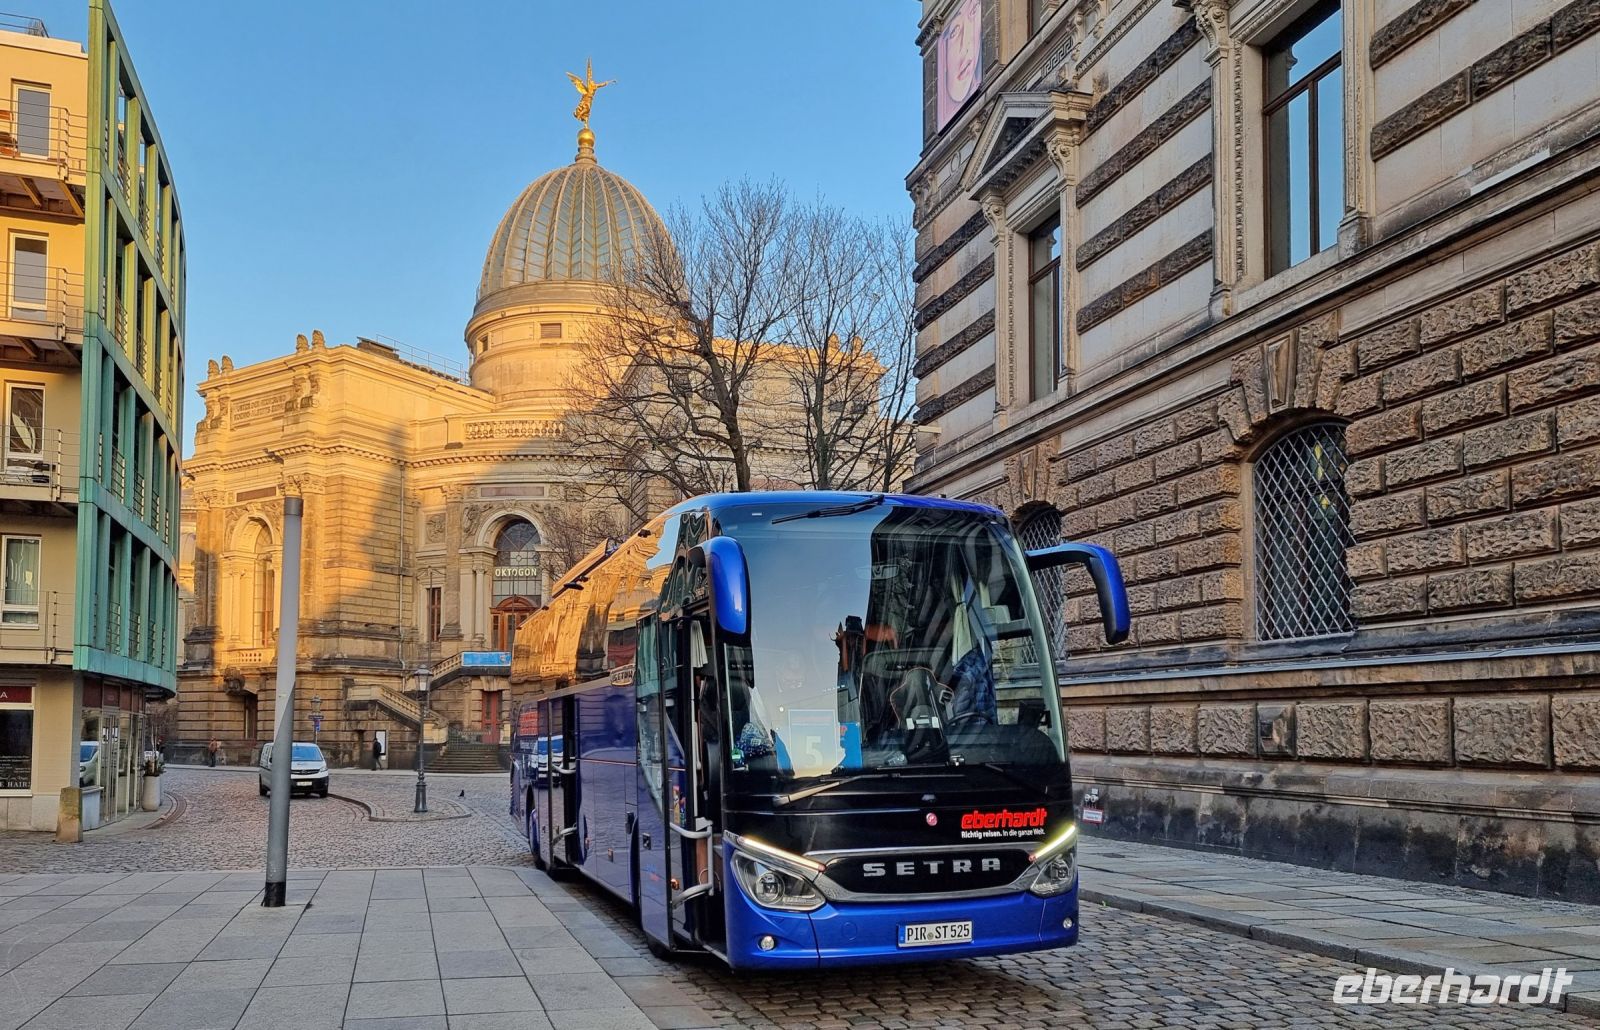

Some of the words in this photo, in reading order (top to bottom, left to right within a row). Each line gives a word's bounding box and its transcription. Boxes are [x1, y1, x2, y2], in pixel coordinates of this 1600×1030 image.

[495, 568, 537, 576] OKTOGON
[961, 808, 1047, 829] eberhardt
[961, 830, 982, 839] Richtig
[983, 829, 1002, 837] reisen.
[863, 858, 1000, 877] SETRA
[907, 926, 926, 941] PIR
